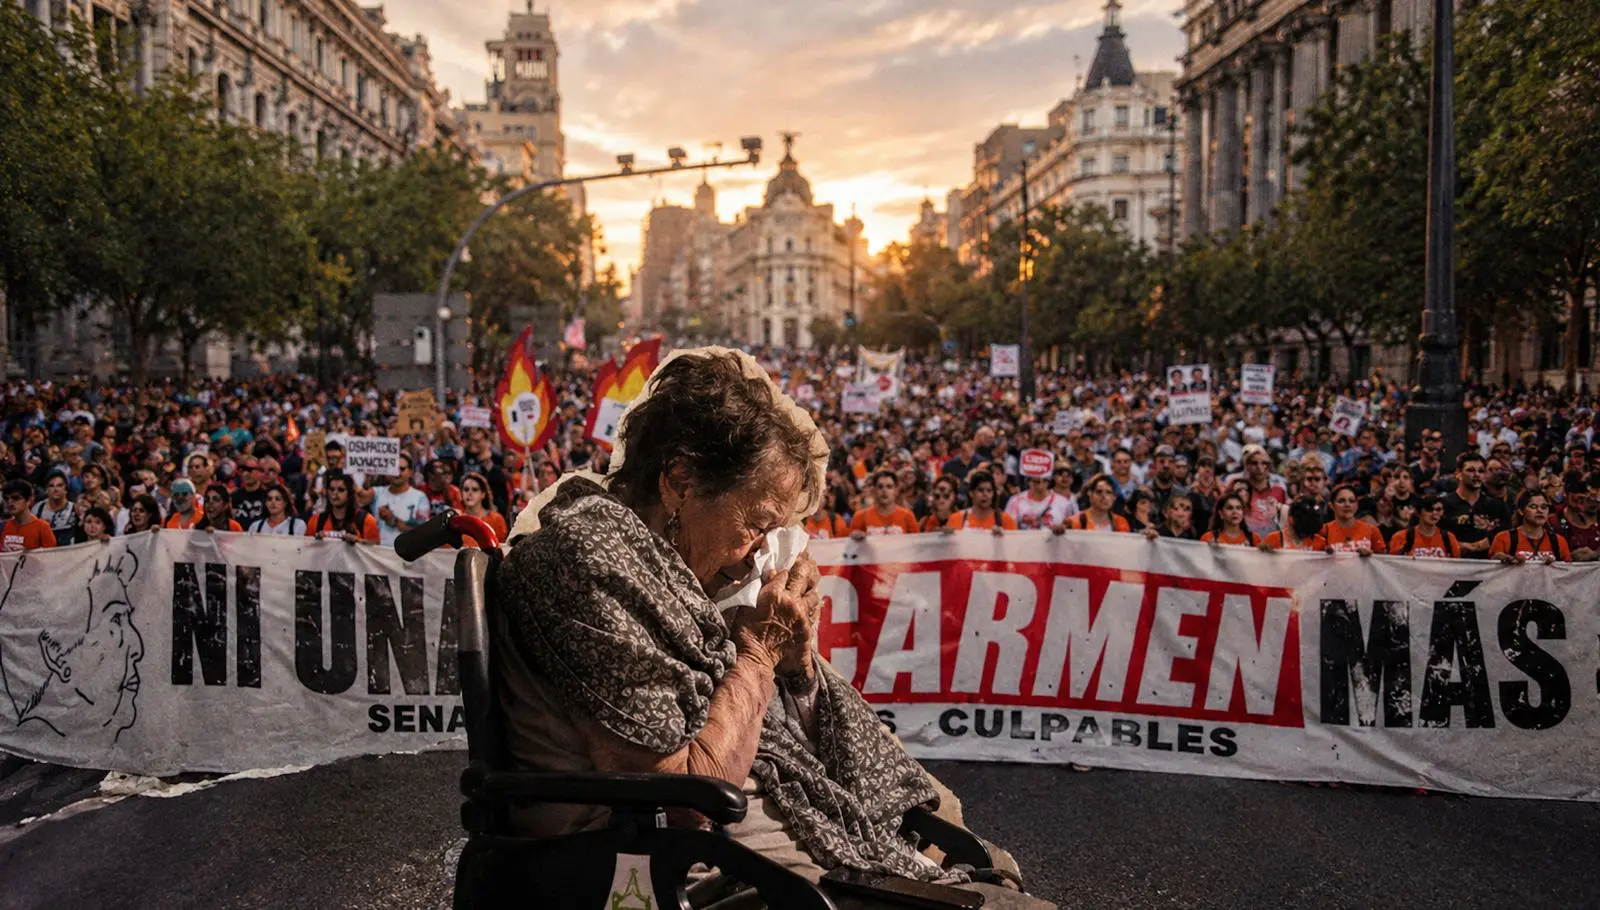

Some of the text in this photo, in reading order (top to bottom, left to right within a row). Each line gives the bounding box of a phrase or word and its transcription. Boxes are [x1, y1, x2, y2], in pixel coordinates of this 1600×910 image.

[172, 562, 261, 688] NI
[1320, 580, 1572, 730] MÁS
[938, 708, 1238, 757] CULPABLES
